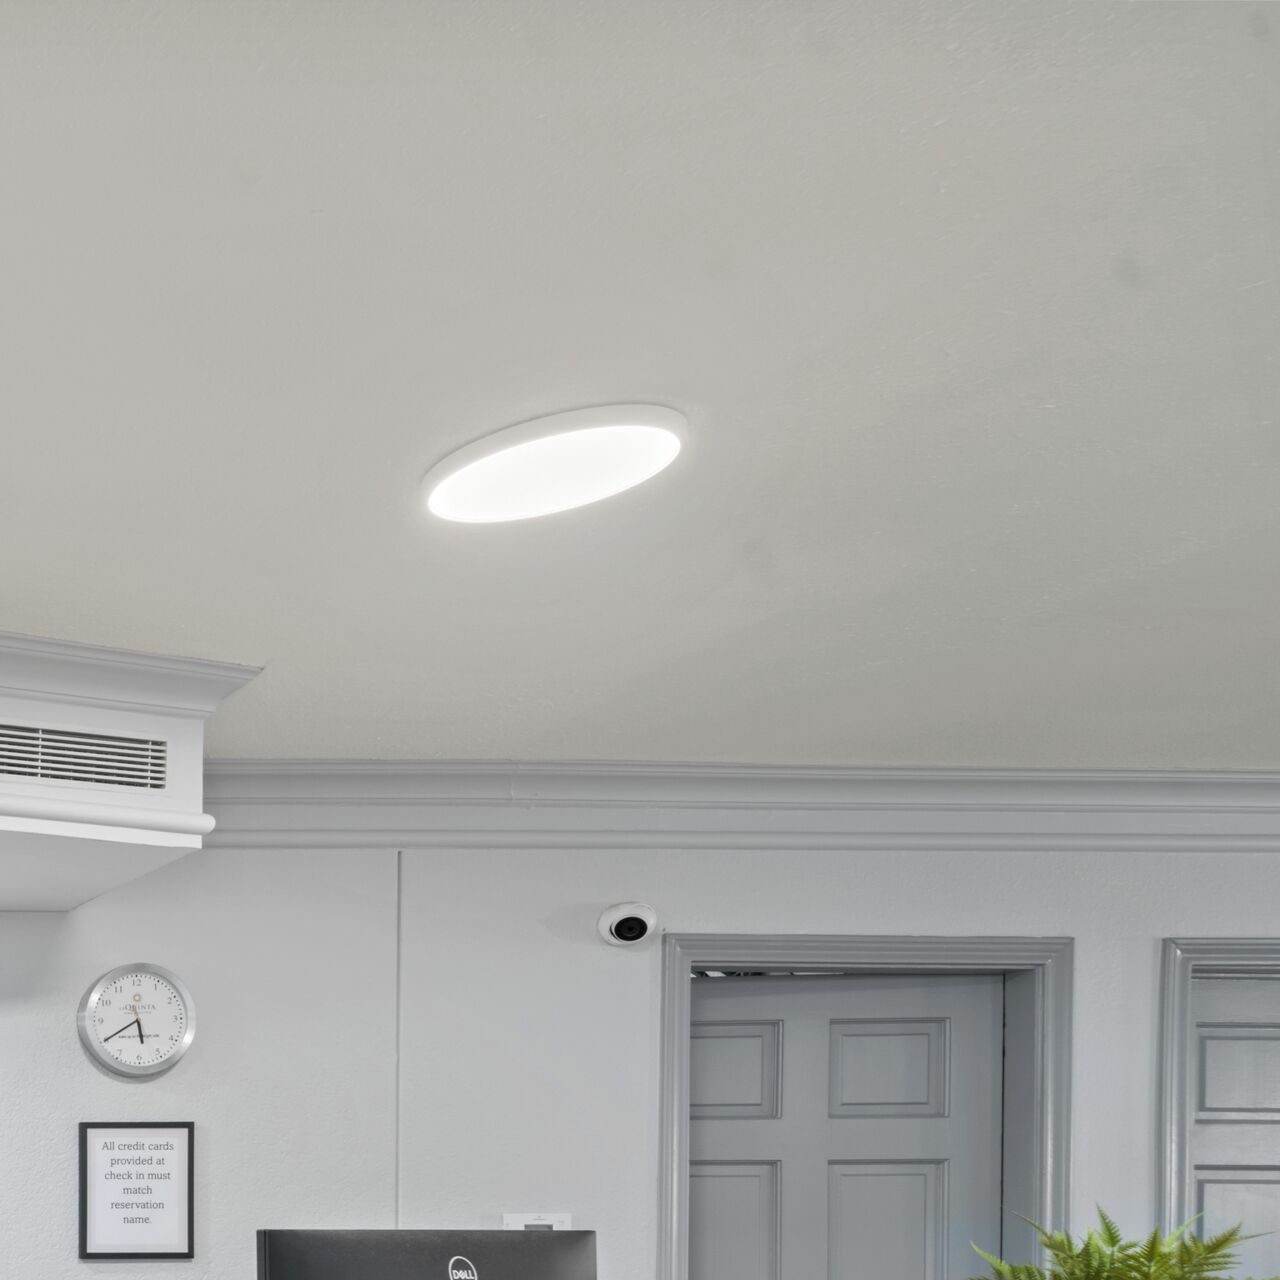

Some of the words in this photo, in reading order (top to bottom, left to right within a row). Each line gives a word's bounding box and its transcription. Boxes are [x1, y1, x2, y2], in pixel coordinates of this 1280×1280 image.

[102, 1141, 115, 1151] All
[118, 1141, 145, 1151] credit
[148, 1141, 174, 1151] cards
[110, 1156, 153, 1167] provided
[156, 1157, 165, 1166] at
[104, 1170, 133, 1180] check
[136, 1171, 144, 1180] in
[147, 1172, 171, 1180] must
[122, 1185, 152, 1194] match
[110, 1200, 164, 1209] reservation
[123, 1216, 152, 1224] name.
[452, 1270, 475, 1280] DELL
